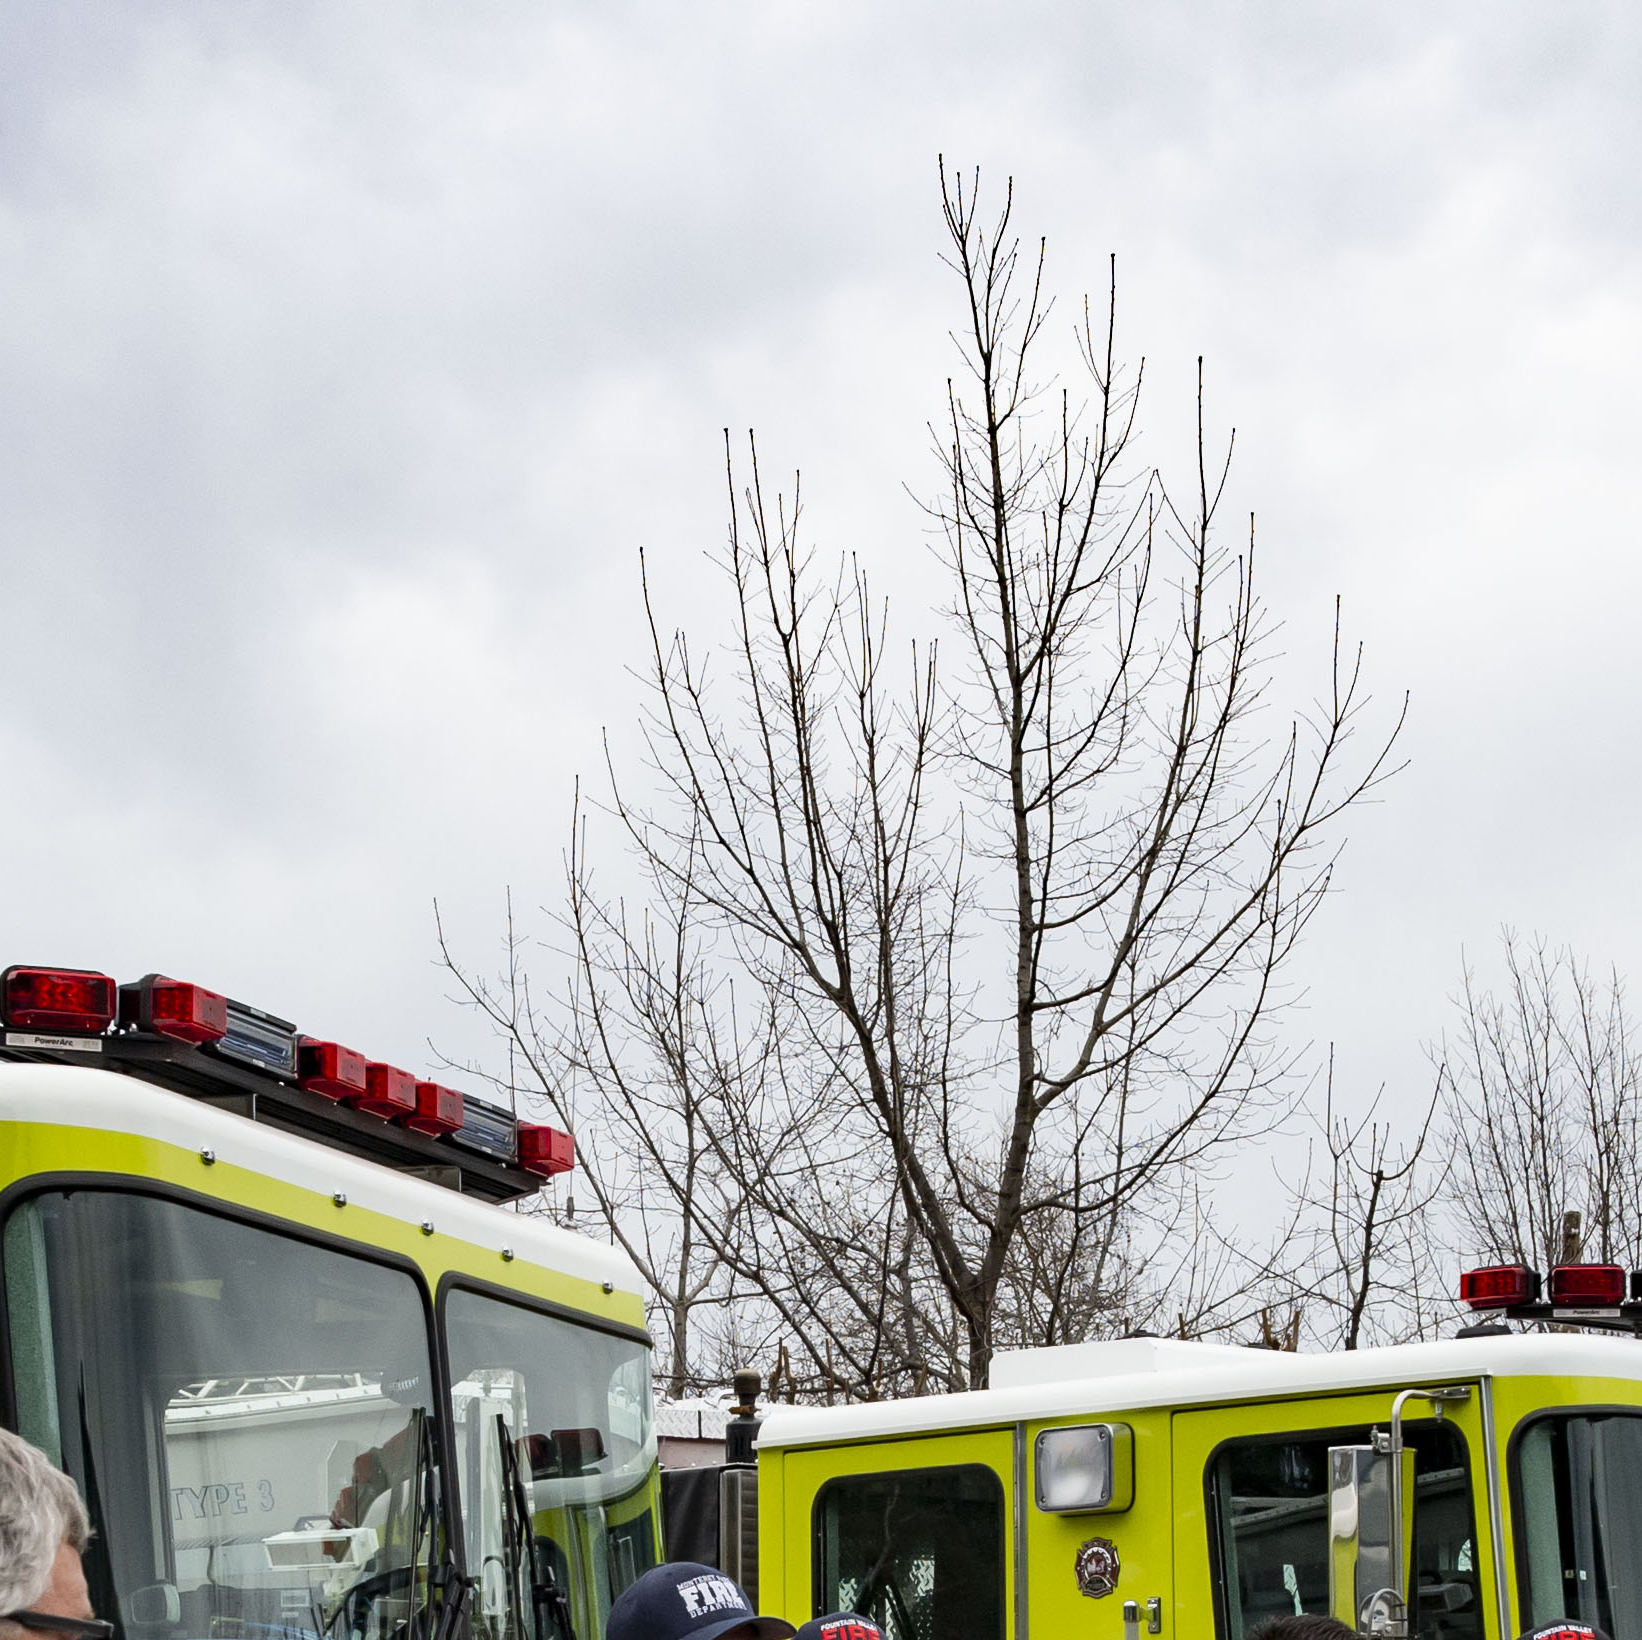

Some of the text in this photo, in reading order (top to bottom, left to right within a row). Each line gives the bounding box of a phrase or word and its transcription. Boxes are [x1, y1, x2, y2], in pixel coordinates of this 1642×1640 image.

[34, 1036, 74, 1047] PowerArc
[170, 1479, 275, 1521] TYPE 3
[679, 1580, 742, 1613] FIRE
